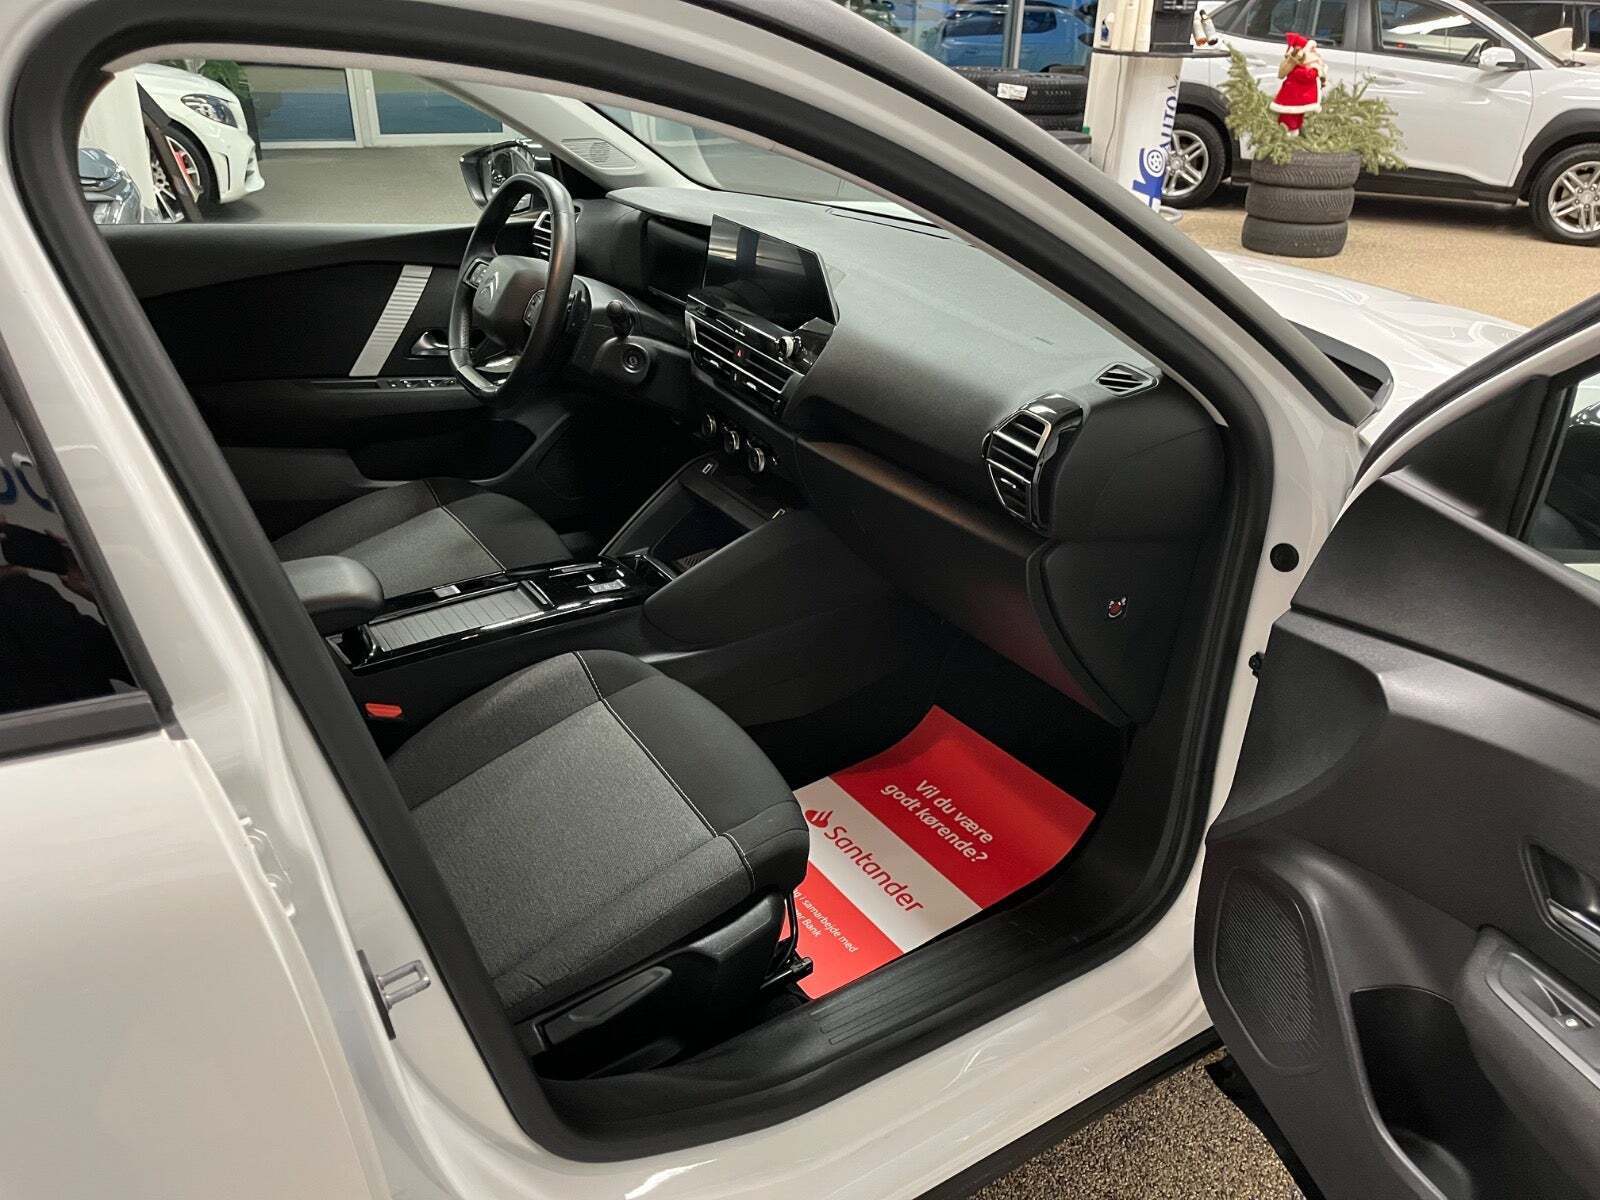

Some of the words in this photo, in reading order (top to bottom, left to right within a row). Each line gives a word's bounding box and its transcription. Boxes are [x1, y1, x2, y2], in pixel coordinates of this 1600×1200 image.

[880, 784, 921, 812] godt
[915, 807, 988, 862] kørende?
[916, 779, 941, 799] Vil
[933, 798, 957, 815] du
[954, 812, 993, 844] være
[823, 825, 924, 912] Santander
[801, 899, 841, 938] samarbejde
[839, 936, 859, 953] med
[802, 918, 822, 938] Bank
